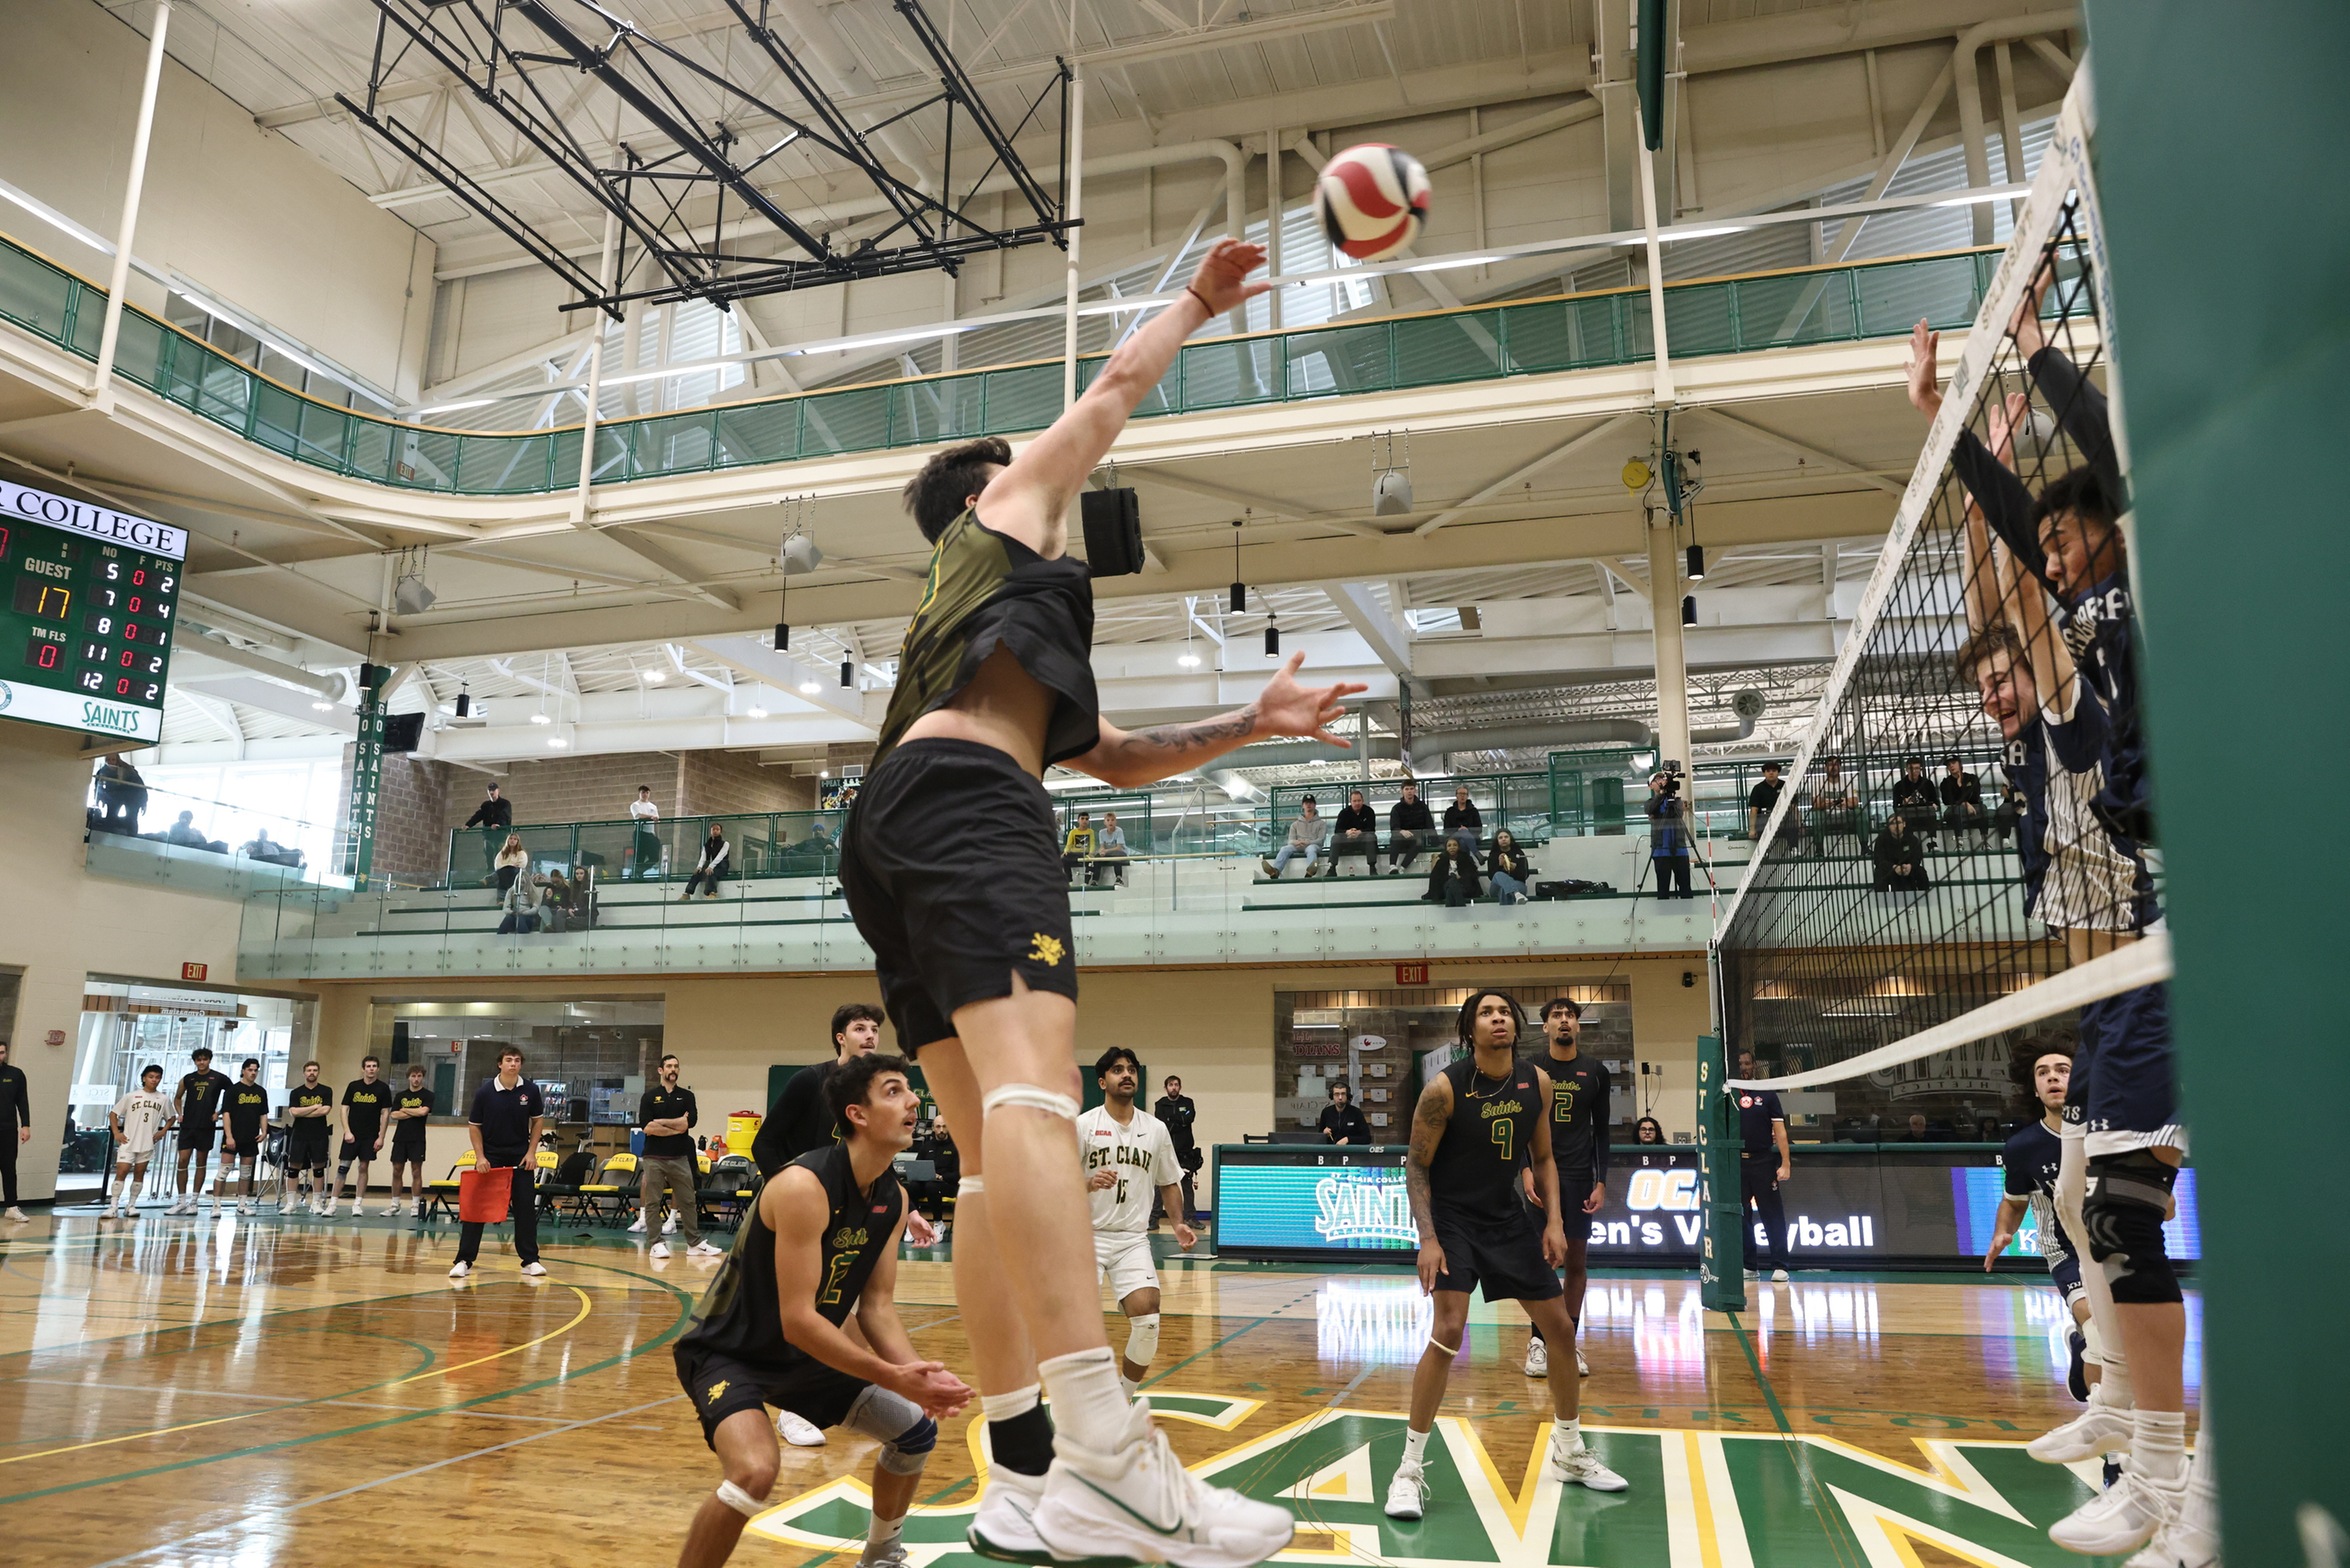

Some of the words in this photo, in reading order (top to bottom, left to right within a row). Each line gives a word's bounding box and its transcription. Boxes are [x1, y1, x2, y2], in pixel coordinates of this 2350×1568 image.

[16, 491, 174, 552] COLLEGE
[25, 557, 72, 580] GUEST
[102, 546, 118, 559] NO
[139, 555, 146, 565] F
[155, 559, 174, 573] PTS
[106, 563, 119, 580] 5
[132, 569, 145, 586] 0
[160, 576, 174, 593] 2
[37, 586, 70, 619] 17
[105, 590, 116, 606] 7
[128, 596, 141, 613] 0
[158, 603, 170, 619] 4
[32, 626, 47, 640] TM
[49, 630, 67, 643] FLS
[97, 617, 111, 634] 8
[124, 623, 137, 640] 0
[158, 631, 166, 645] 1
[38, 645, 57, 668] 0
[87, 644, 107, 661] 11
[120, 651, 133, 667] 0
[149, 656, 163, 673] 2
[83, 672, 103, 690] 12
[117, 678, 130, 694] 0
[145, 683, 159, 700] 2
[82, 701, 140, 732] SAINTS
[376, 703, 385, 733] GO
[350, 742, 367, 838] SAINTS
[364, 742, 381, 839] SAINTS
[187, 963, 204, 979] EXIT
[1402, 966, 1423, 982] EXIT
[1293, 1031, 1312, 1042] LL
[1295, 1043, 1341, 1056] DIANS
[196, 1086, 206, 1100] 7
[1700, 1061, 1708, 1111] ST
[143, 1112, 149, 1123] 3
[1480, 1100, 1523, 1119] Saints
[1555, 1092, 1573, 1122] 2
[1491, 1117, 1514, 1160] 9
[1089, 1147, 1111, 1169] ST.
[1318, 1156, 1324, 1165] B
[1342, 1156, 1349, 1165] P
[1642, 1156, 1649, 1166] B
[1669, 1156, 1676, 1165] P
[1996, 1155, 2003, 1165] B
[1626, 1168, 1700, 1211] OC
[1699, 1125, 1713, 1260] CLAIR
[1315, 1178, 1417, 1233] SAINT
[1587, 1215, 1663, 1246] en's
[1674, 1215, 1874, 1253] Veyball
